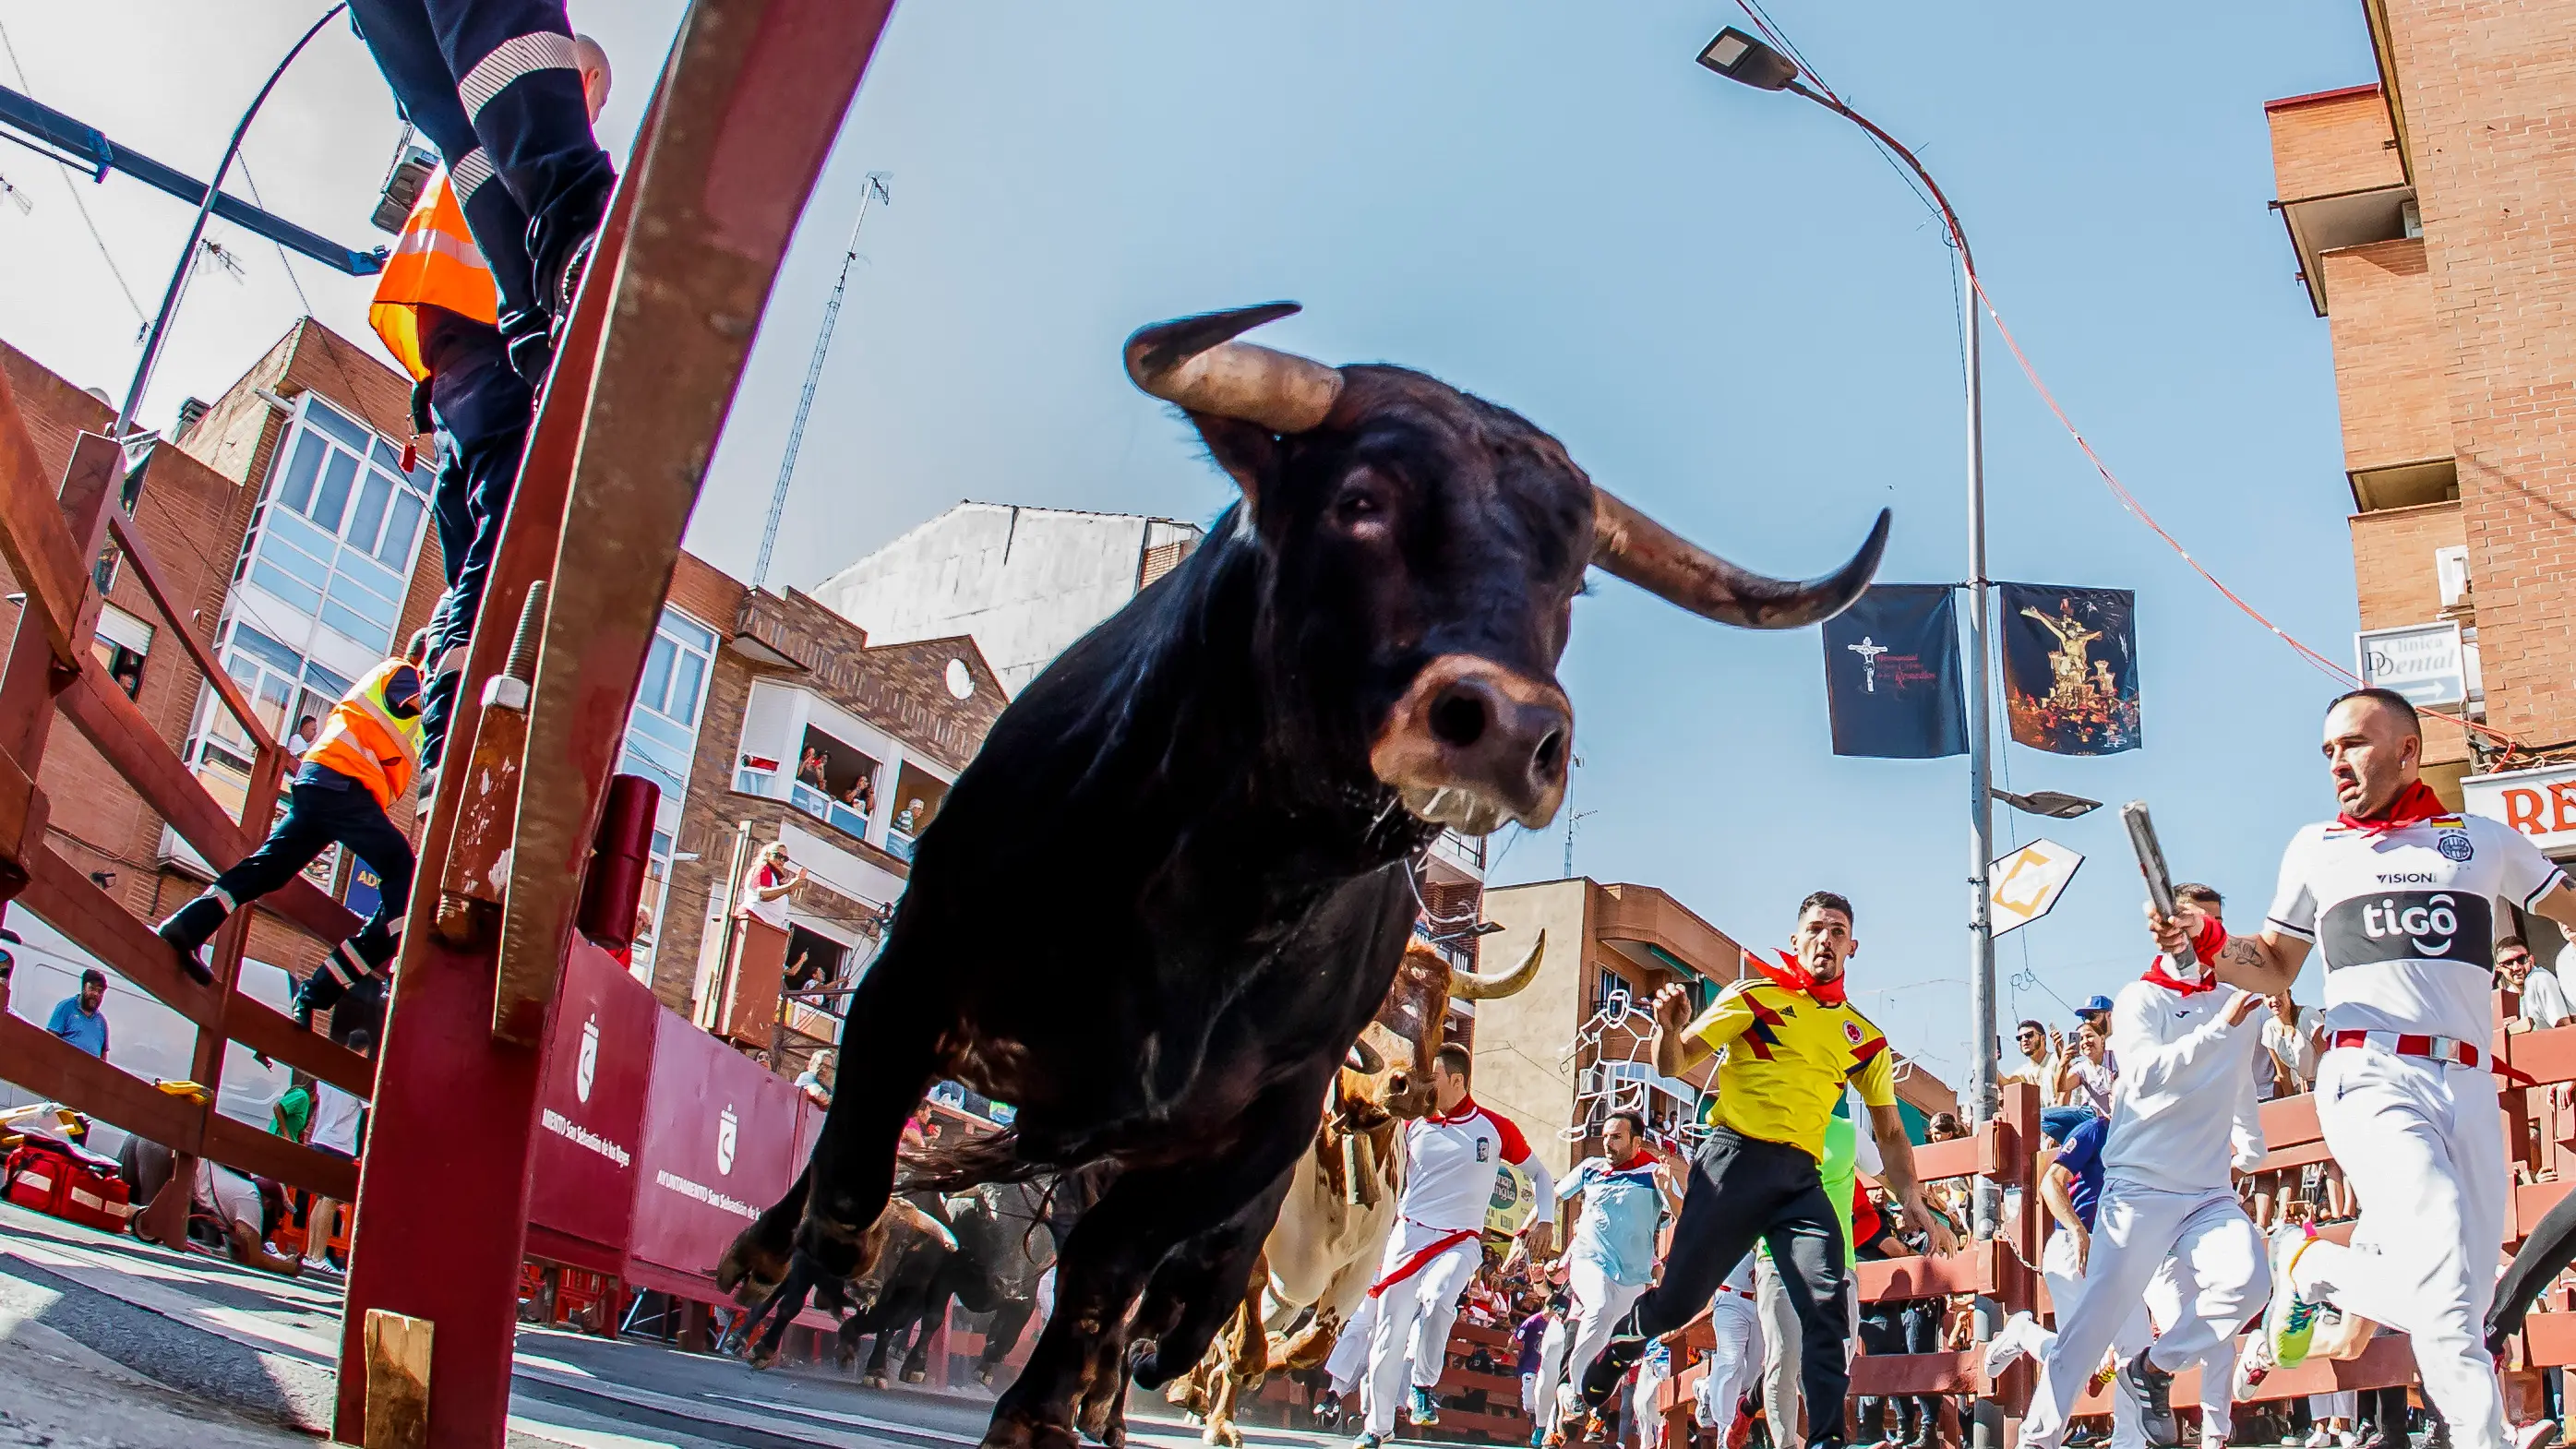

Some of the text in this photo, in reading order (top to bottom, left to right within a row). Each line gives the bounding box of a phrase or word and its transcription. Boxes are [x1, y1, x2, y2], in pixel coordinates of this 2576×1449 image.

[2377, 873, 2433, 883] VISION
[565, 1120, 577, 1141] San
[656, 1169, 708, 1203] AYUNTAMIENTO
[708, 1189, 720, 1207] San
